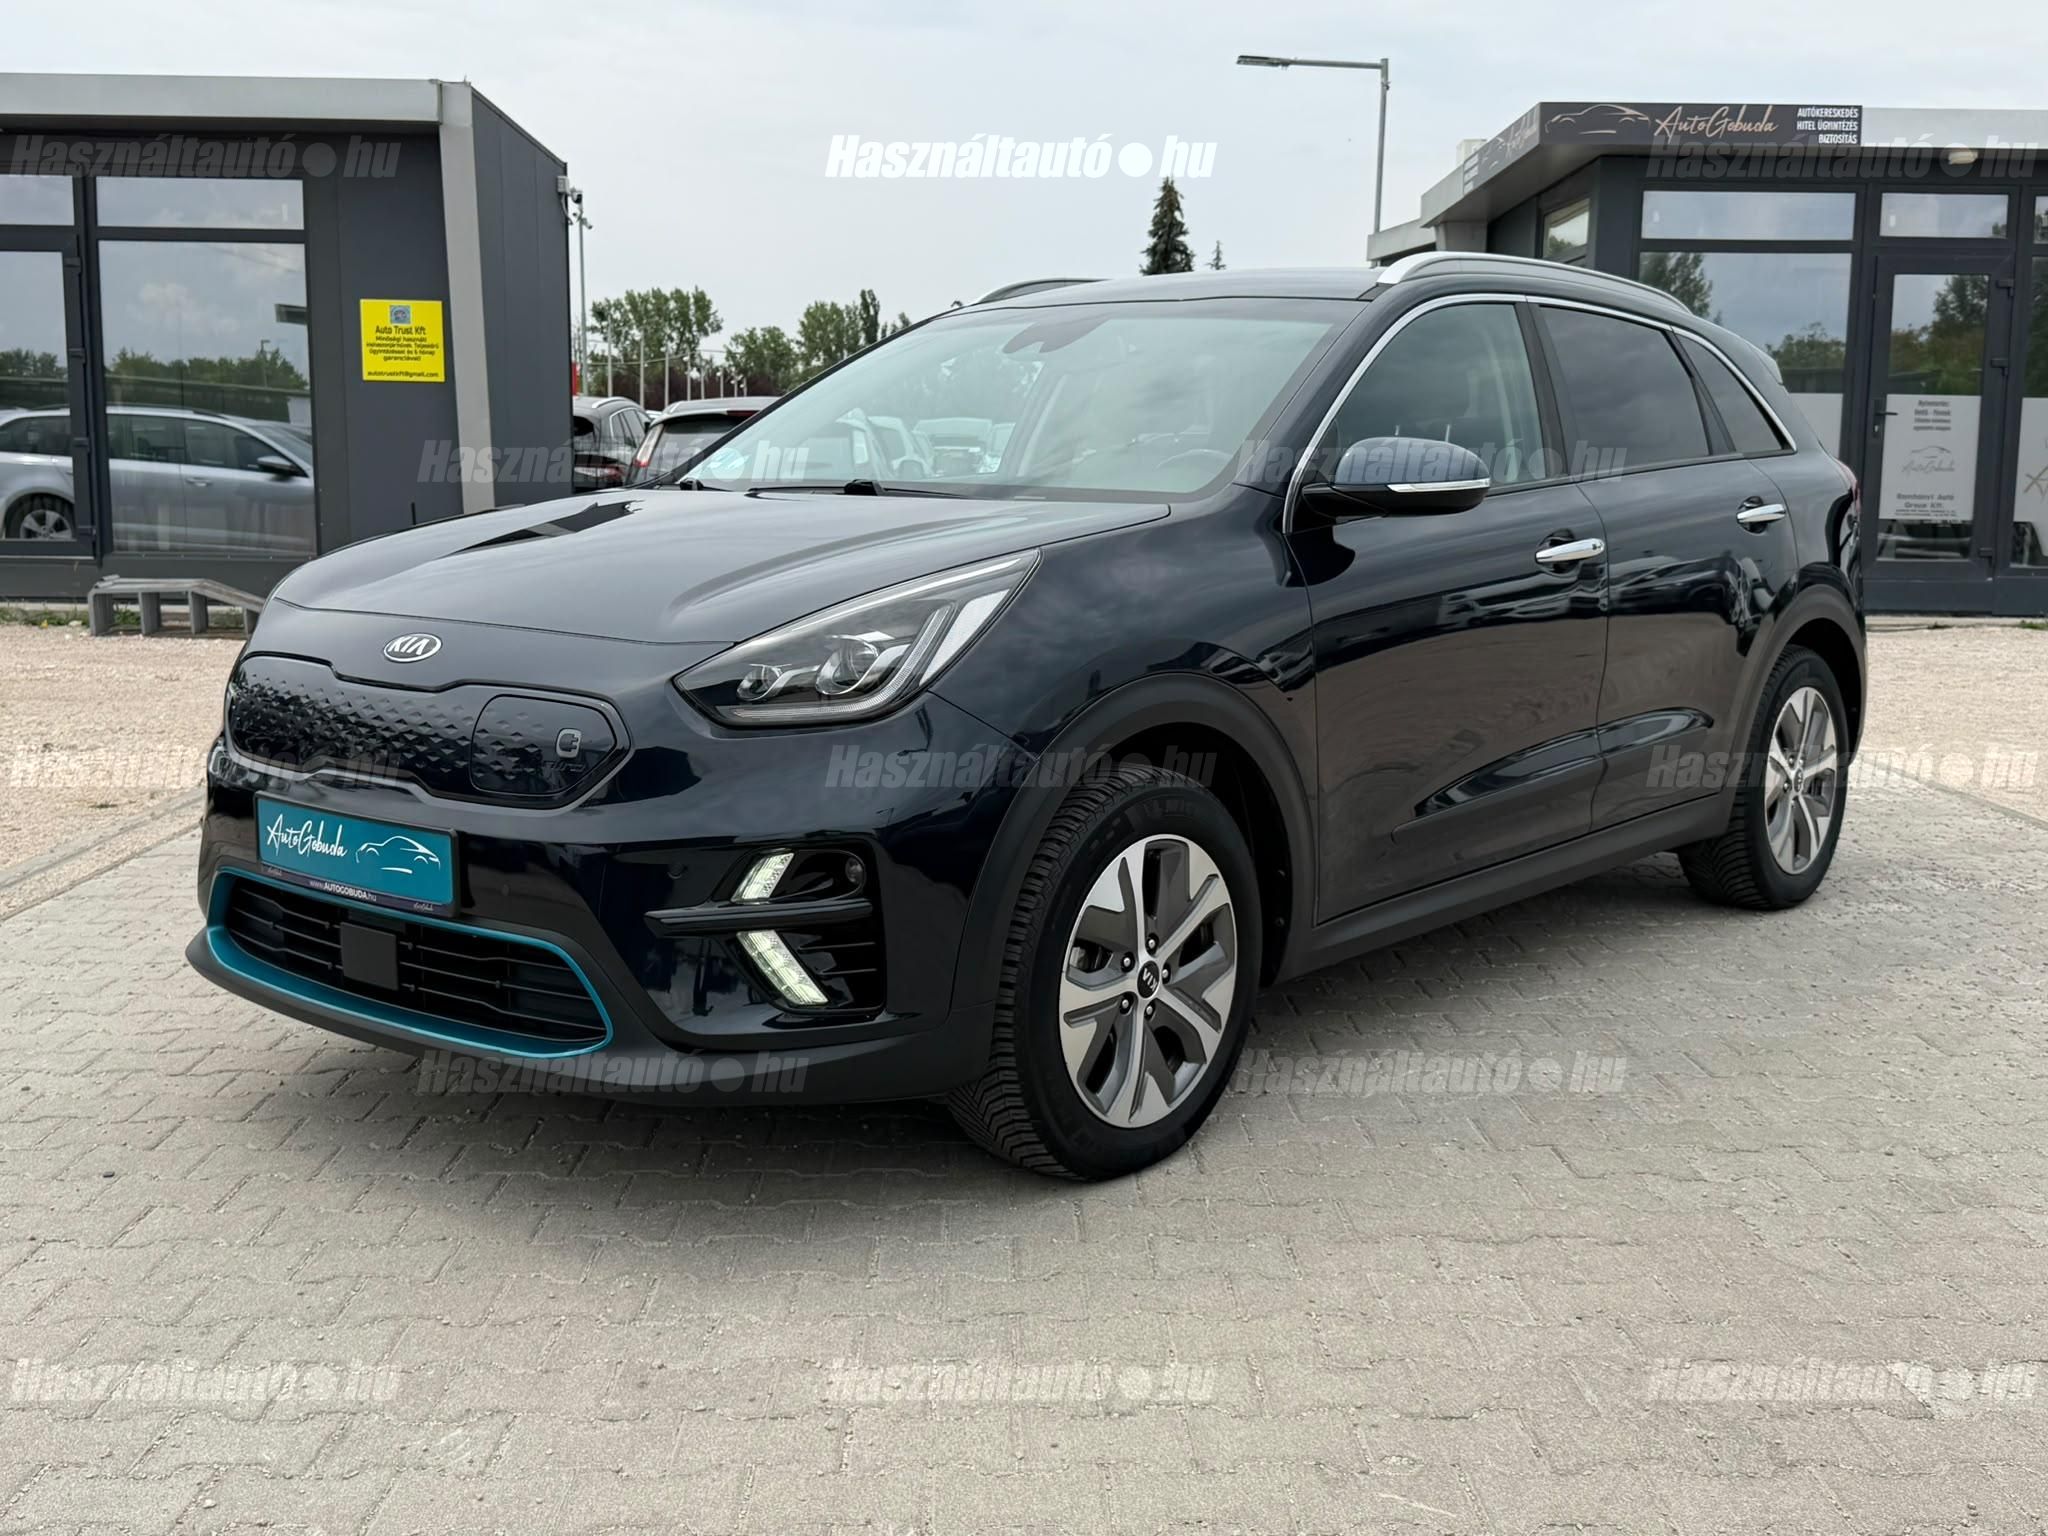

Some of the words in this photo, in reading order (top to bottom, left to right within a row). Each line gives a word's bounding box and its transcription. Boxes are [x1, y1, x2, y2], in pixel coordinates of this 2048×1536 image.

[1796, 107, 1859, 118] AUTÓKERESKEDÉS
[1796, 120, 1816, 131] HITEL
[375, 325, 392, 335] Auto
[394, 325, 413, 335] Trust
[387, 636, 430, 656] KIA
[266, 813, 348, 858] AutoGobuda
